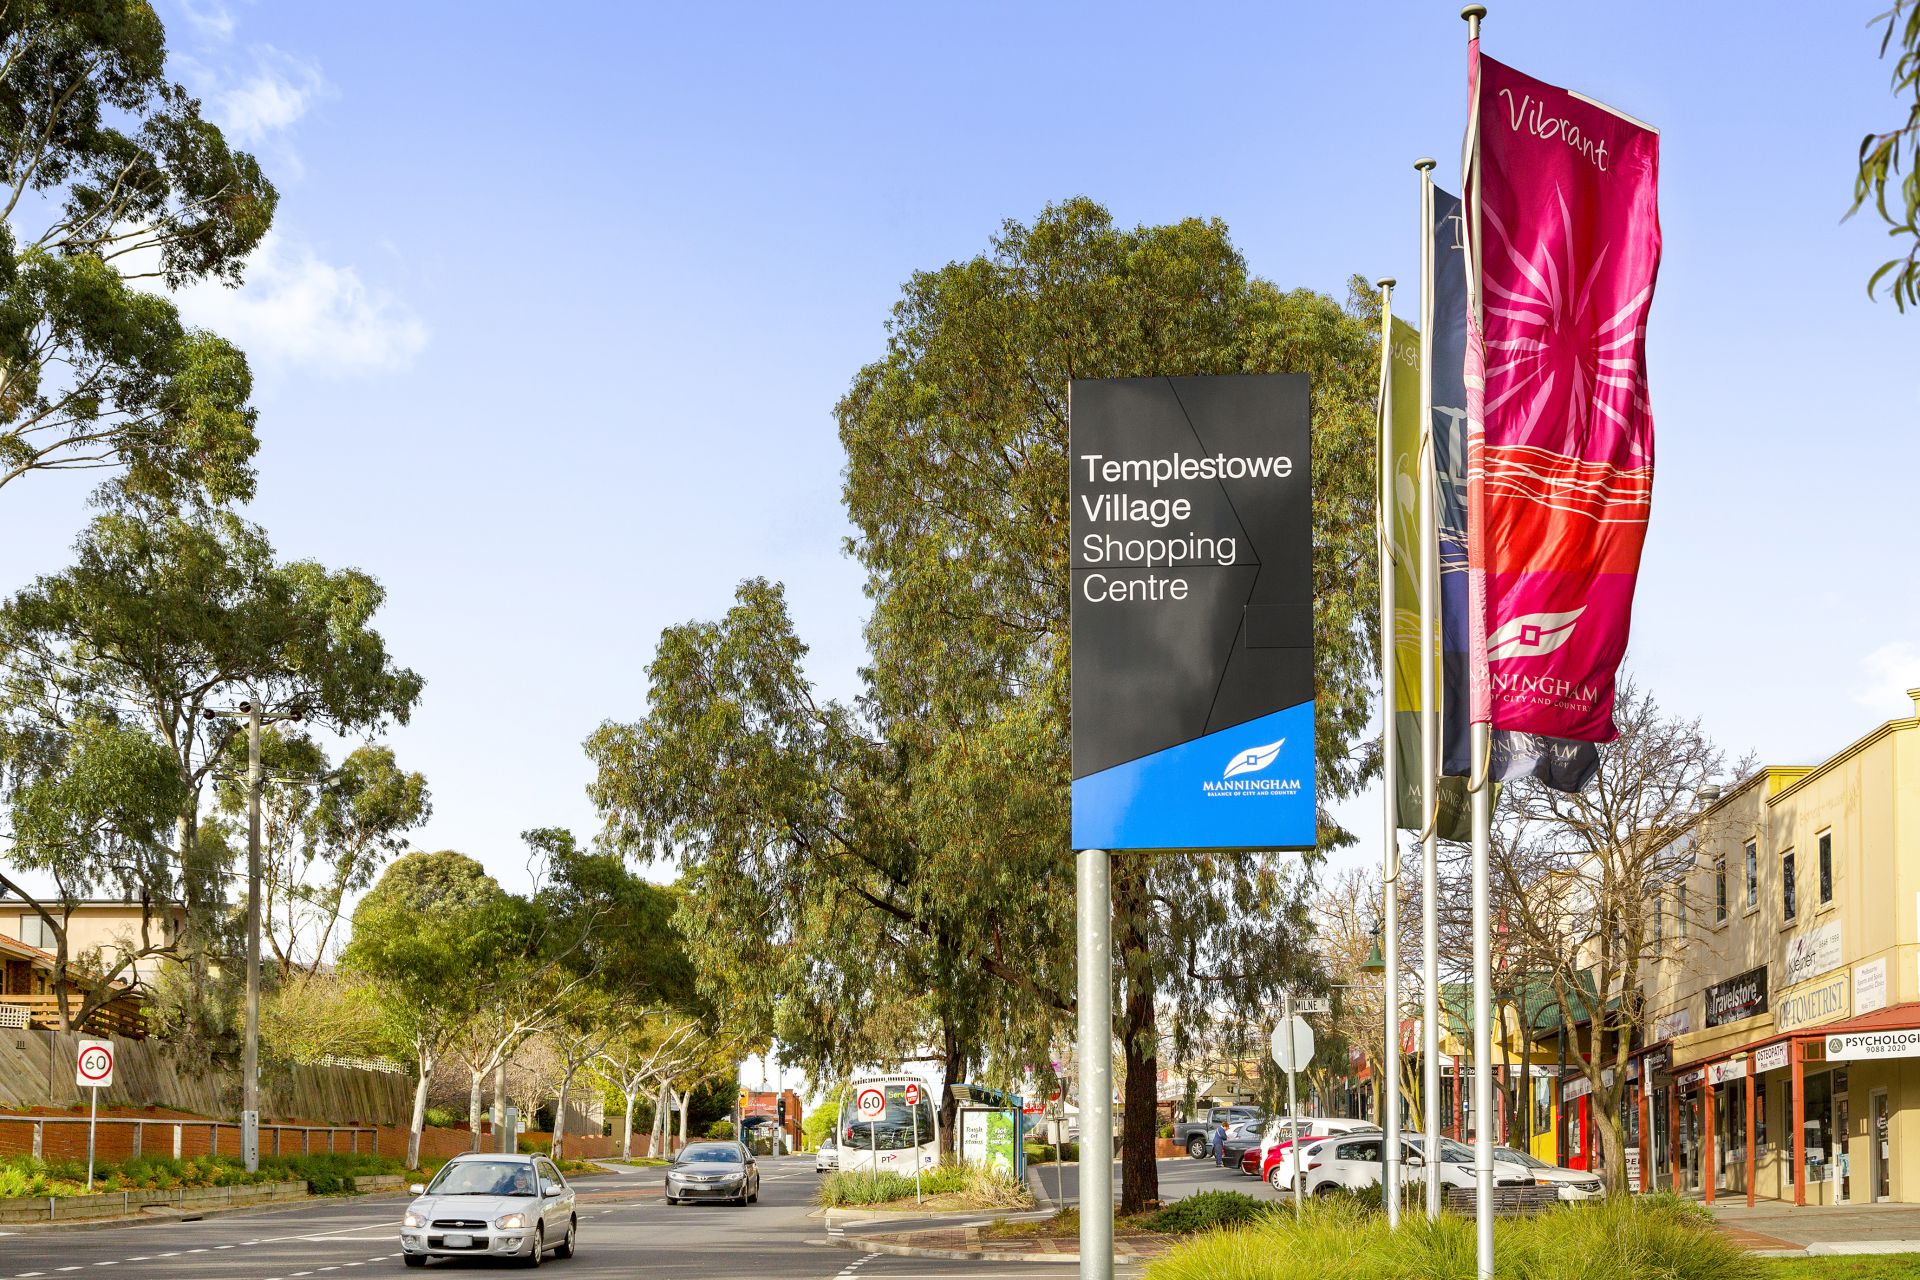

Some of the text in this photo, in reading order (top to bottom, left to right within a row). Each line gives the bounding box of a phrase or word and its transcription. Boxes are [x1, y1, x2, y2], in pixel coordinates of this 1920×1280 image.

[1499, 88, 1608, 171] Vibrant
[1080, 452, 1293, 488] Templestowe
[1081, 493, 1192, 528] Village
[1083, 531, 1237, 568] Shopping
[1083, 573, 1189, 603] Centre
[1503, 694, 1528, 703] CITY
[1530, 697, 1551, 705] AND
[1203, 779, 1301, 791] MANNINGHAM
[1294, 1000, 1318, 1011] MILNE
[1711, 982, 1757, 1015] Travelstore
[1780, 981, 1843, 1029] OPTOMETRIST
[1757, 1046, 1784, 1061] OSTEOPATH
[1887, 1044, 1906, 1052] 2020
[85, 1055, 106, 1070] 60
[863, 1096, 880, 1109] 60
